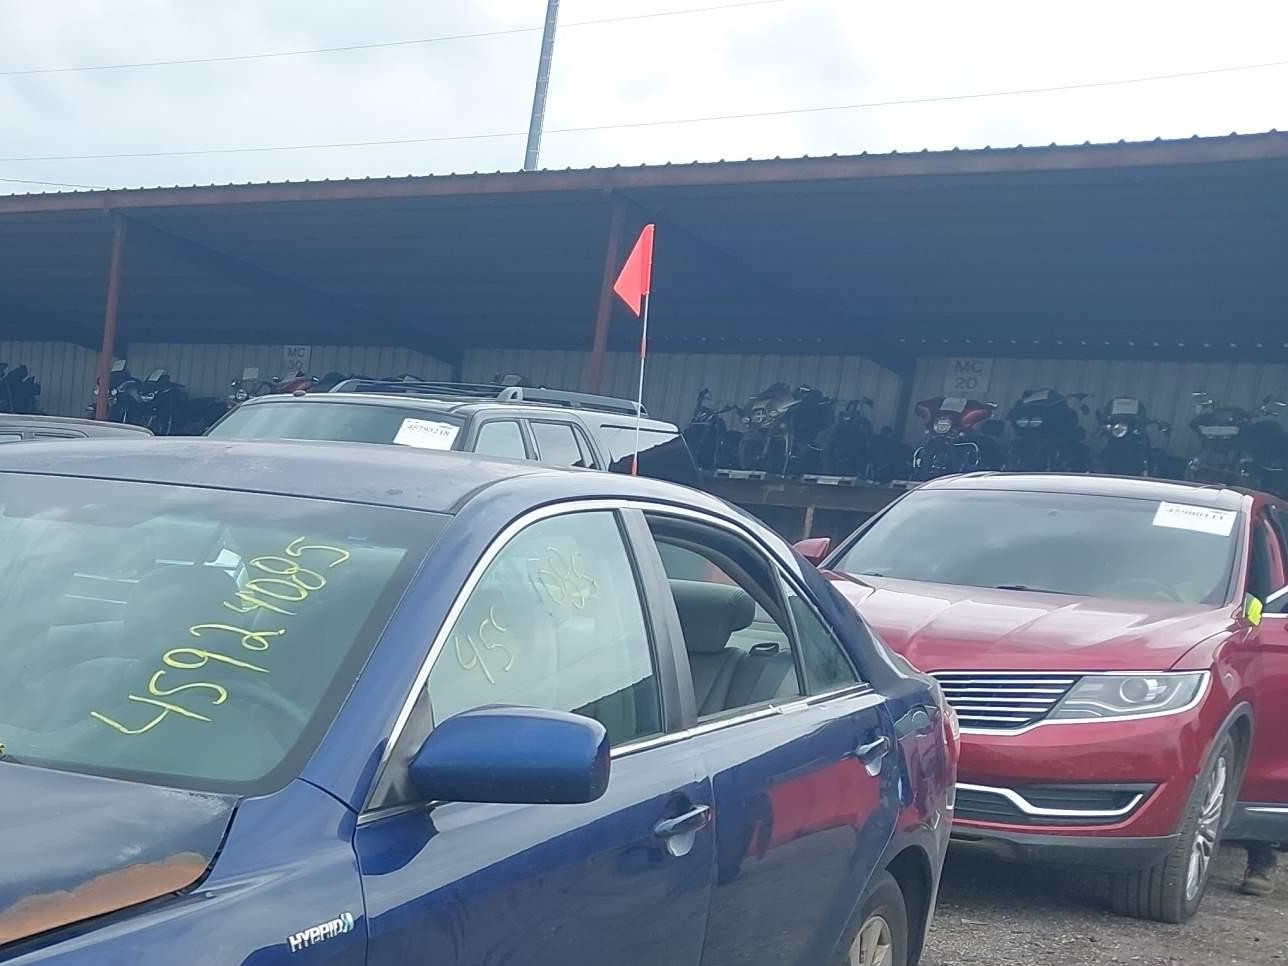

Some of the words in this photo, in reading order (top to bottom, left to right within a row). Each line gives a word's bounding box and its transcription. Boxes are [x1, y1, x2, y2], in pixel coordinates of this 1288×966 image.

[288, 347, 305, 358] MC
[954, 360, 984, 373] MC
[954, 377, 978, 390] 20
[91, 536, 350, 733] 45924085
[288, 916, 346, 953] HYBRID
